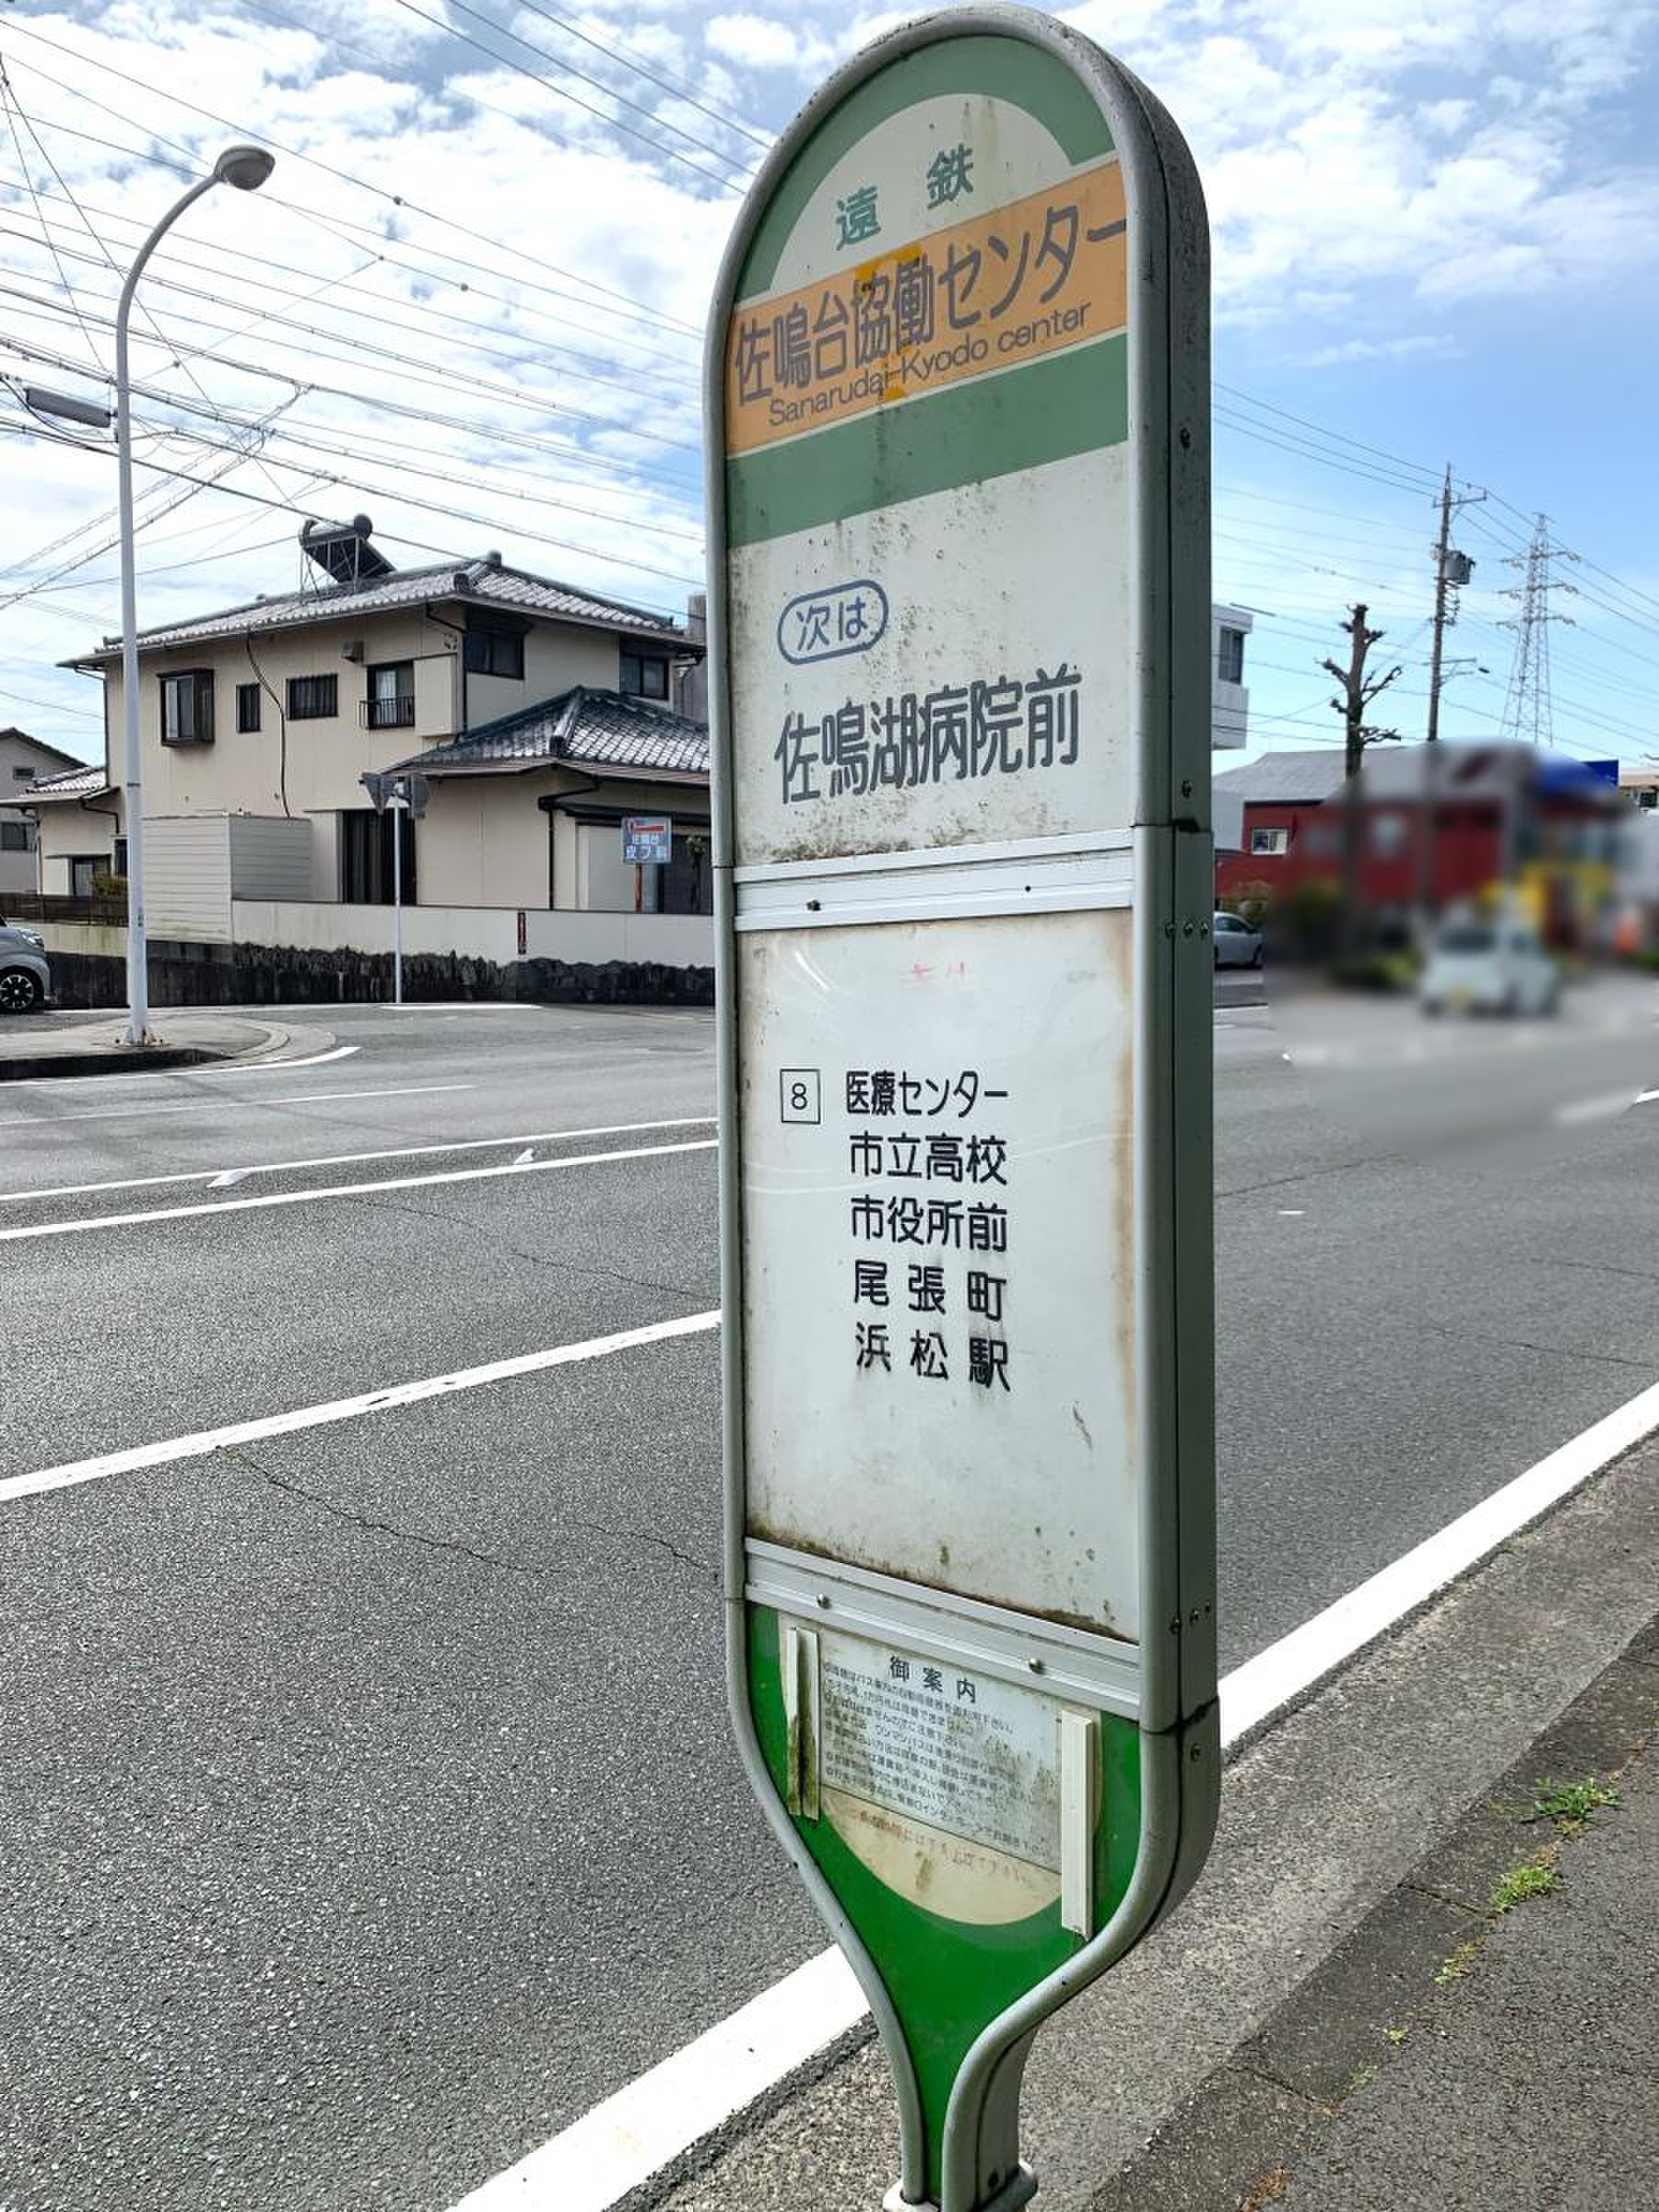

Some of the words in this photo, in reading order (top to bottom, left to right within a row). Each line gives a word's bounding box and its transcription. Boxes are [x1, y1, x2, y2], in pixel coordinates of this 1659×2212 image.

[836, 145, 975, 250] 遠鉄
[736, 205, 1126, 405] 佐鳴台協働センター
[767, 338, 989, 426] Sanarudai-Kyodo
[998, 301, 1092, 353] center
[795, 596, 867, 651] 次は
[774, 664, 1083, 805] 佐鳴湖病院前
[791, 1082, 808, 1111] 8
[845, 1070, 1008, 1118] 医療センター
[850, 1130, 1007, 1186] 市立高校
[851, 1194, 1007, 1253] 市役所前
[853, 1259, 1007, 1322] 尾張町
[855, 1322, 1011, 1393] 浜松駅
[888, 1655, 977, 1703] 御案内
